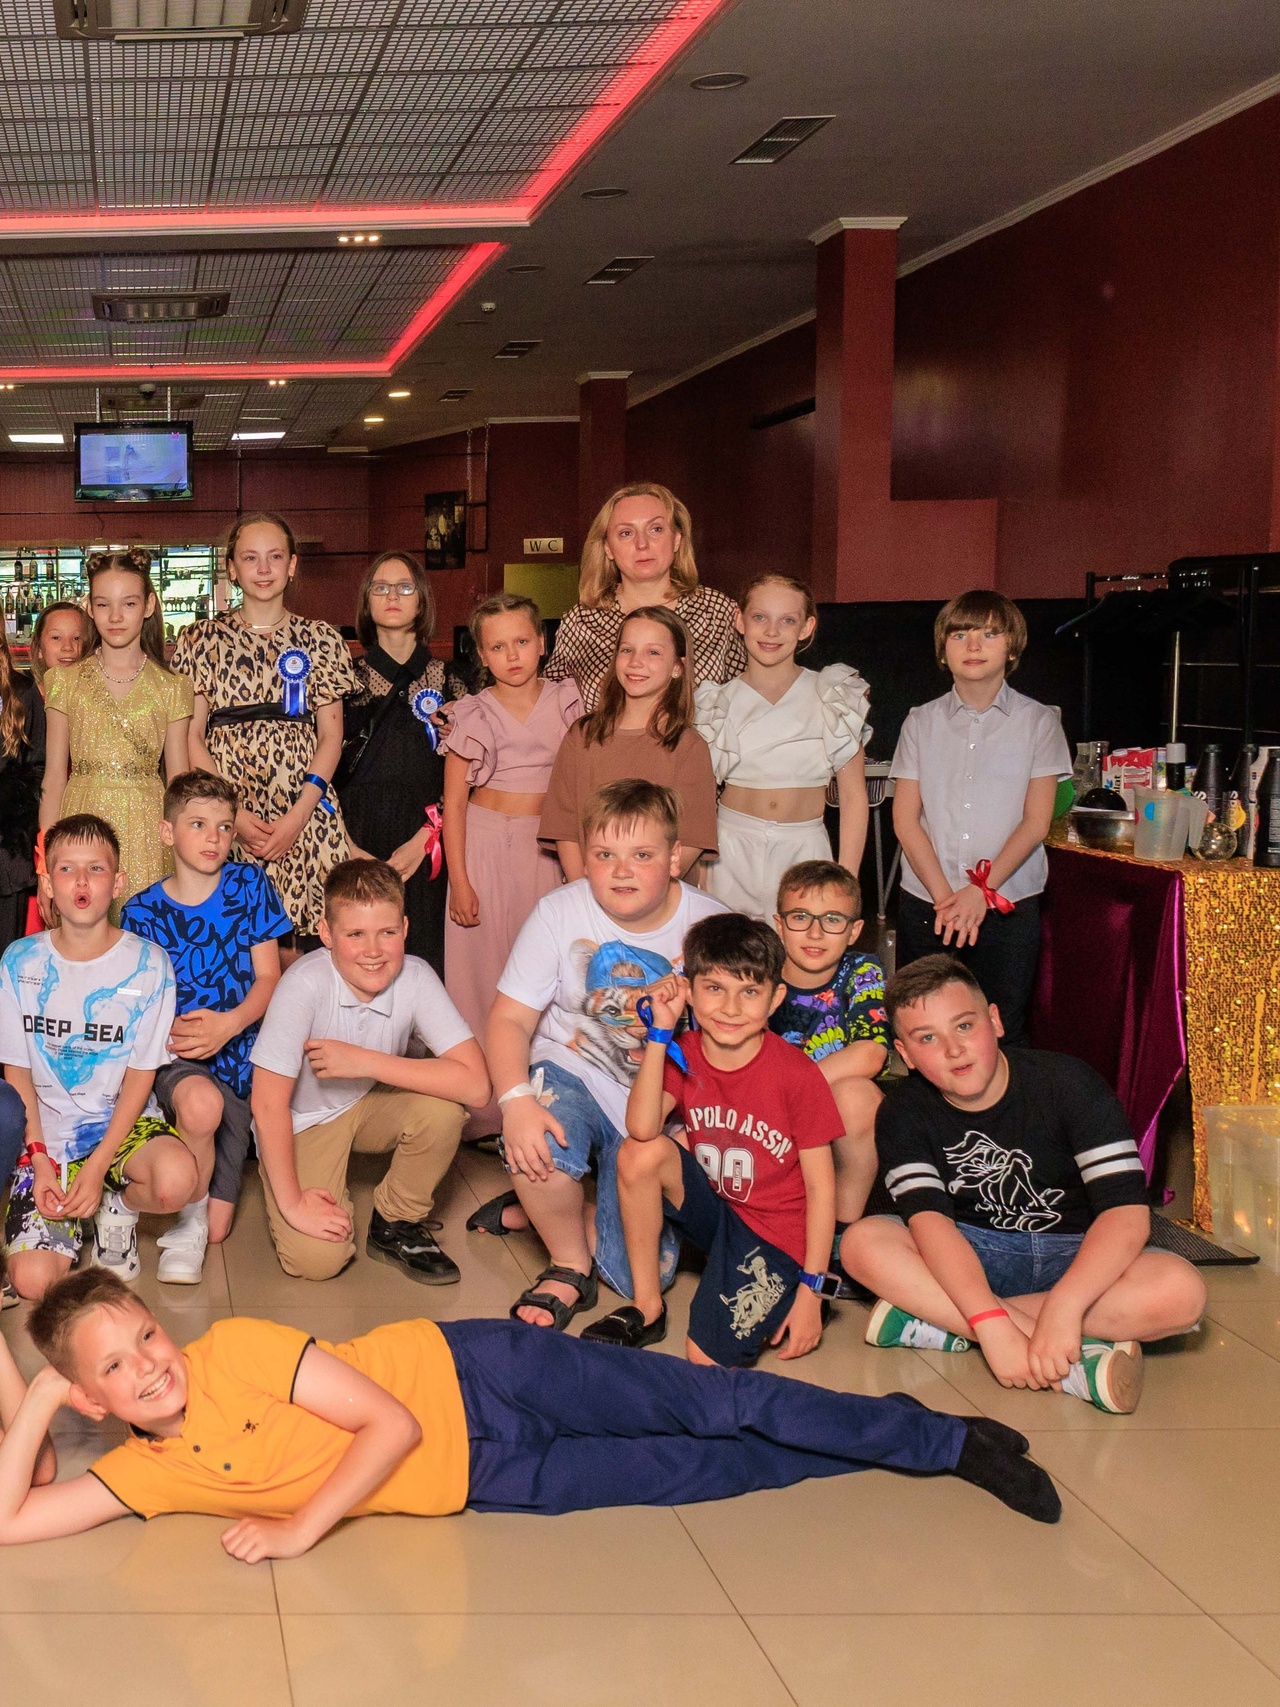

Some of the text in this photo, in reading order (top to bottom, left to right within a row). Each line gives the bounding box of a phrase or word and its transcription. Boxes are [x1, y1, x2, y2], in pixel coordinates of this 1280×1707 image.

[23, 1014, 124, 1044] DEEP SEA
[689, 1105, 737, 1131] POLO
